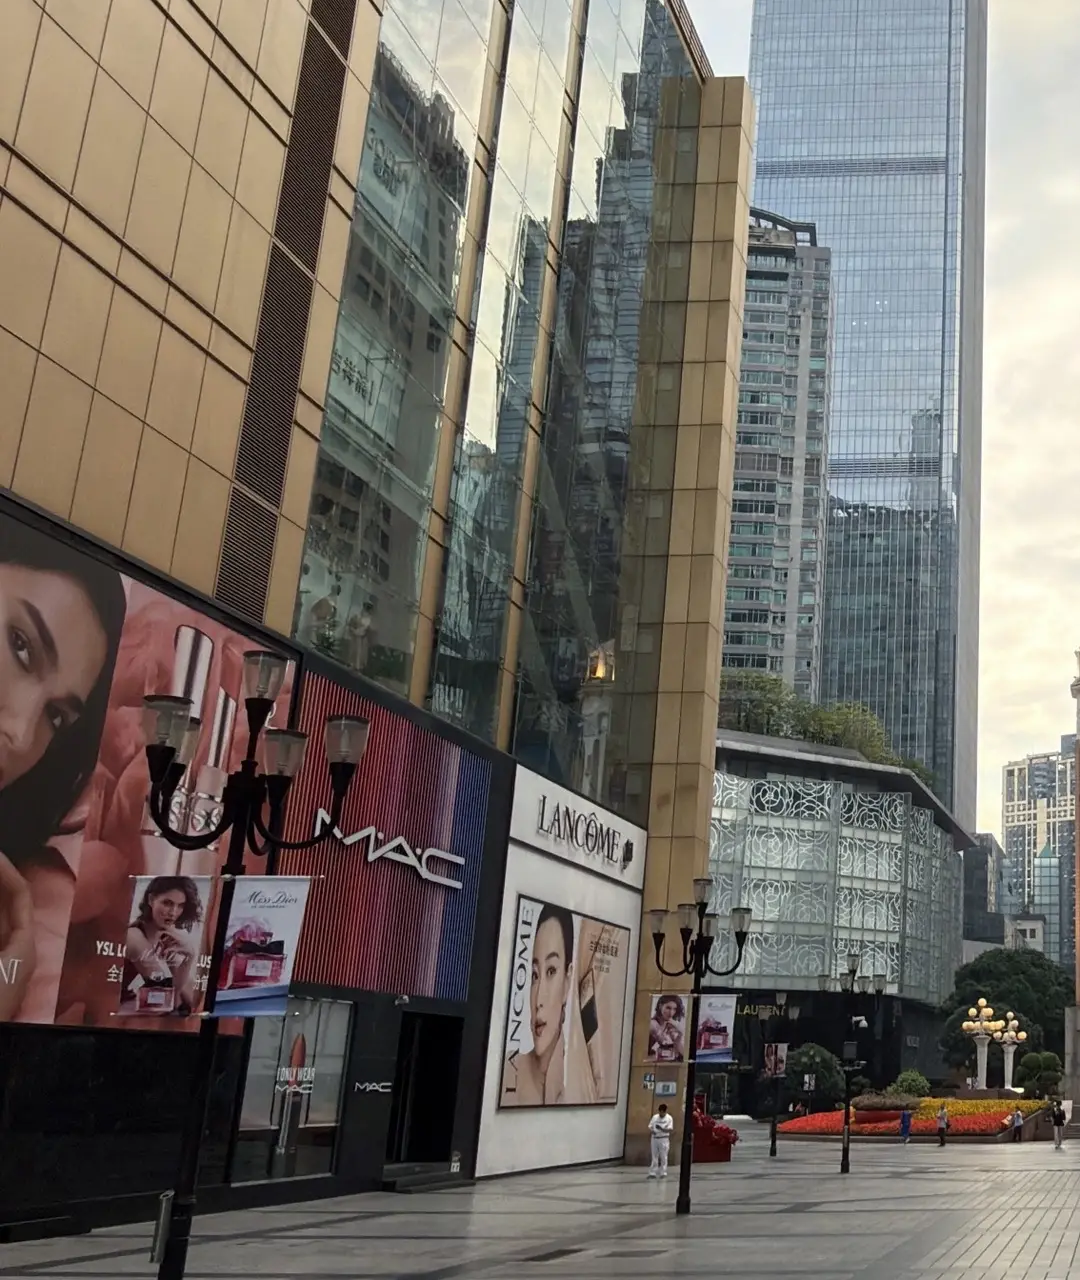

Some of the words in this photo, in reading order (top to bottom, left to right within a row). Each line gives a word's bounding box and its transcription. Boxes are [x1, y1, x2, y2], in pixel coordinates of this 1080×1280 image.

[539, 794, 621, 863] LANCÔME
[96, 940, 115, 957] YSL
[354, 1081, 393, 1093] MAC
